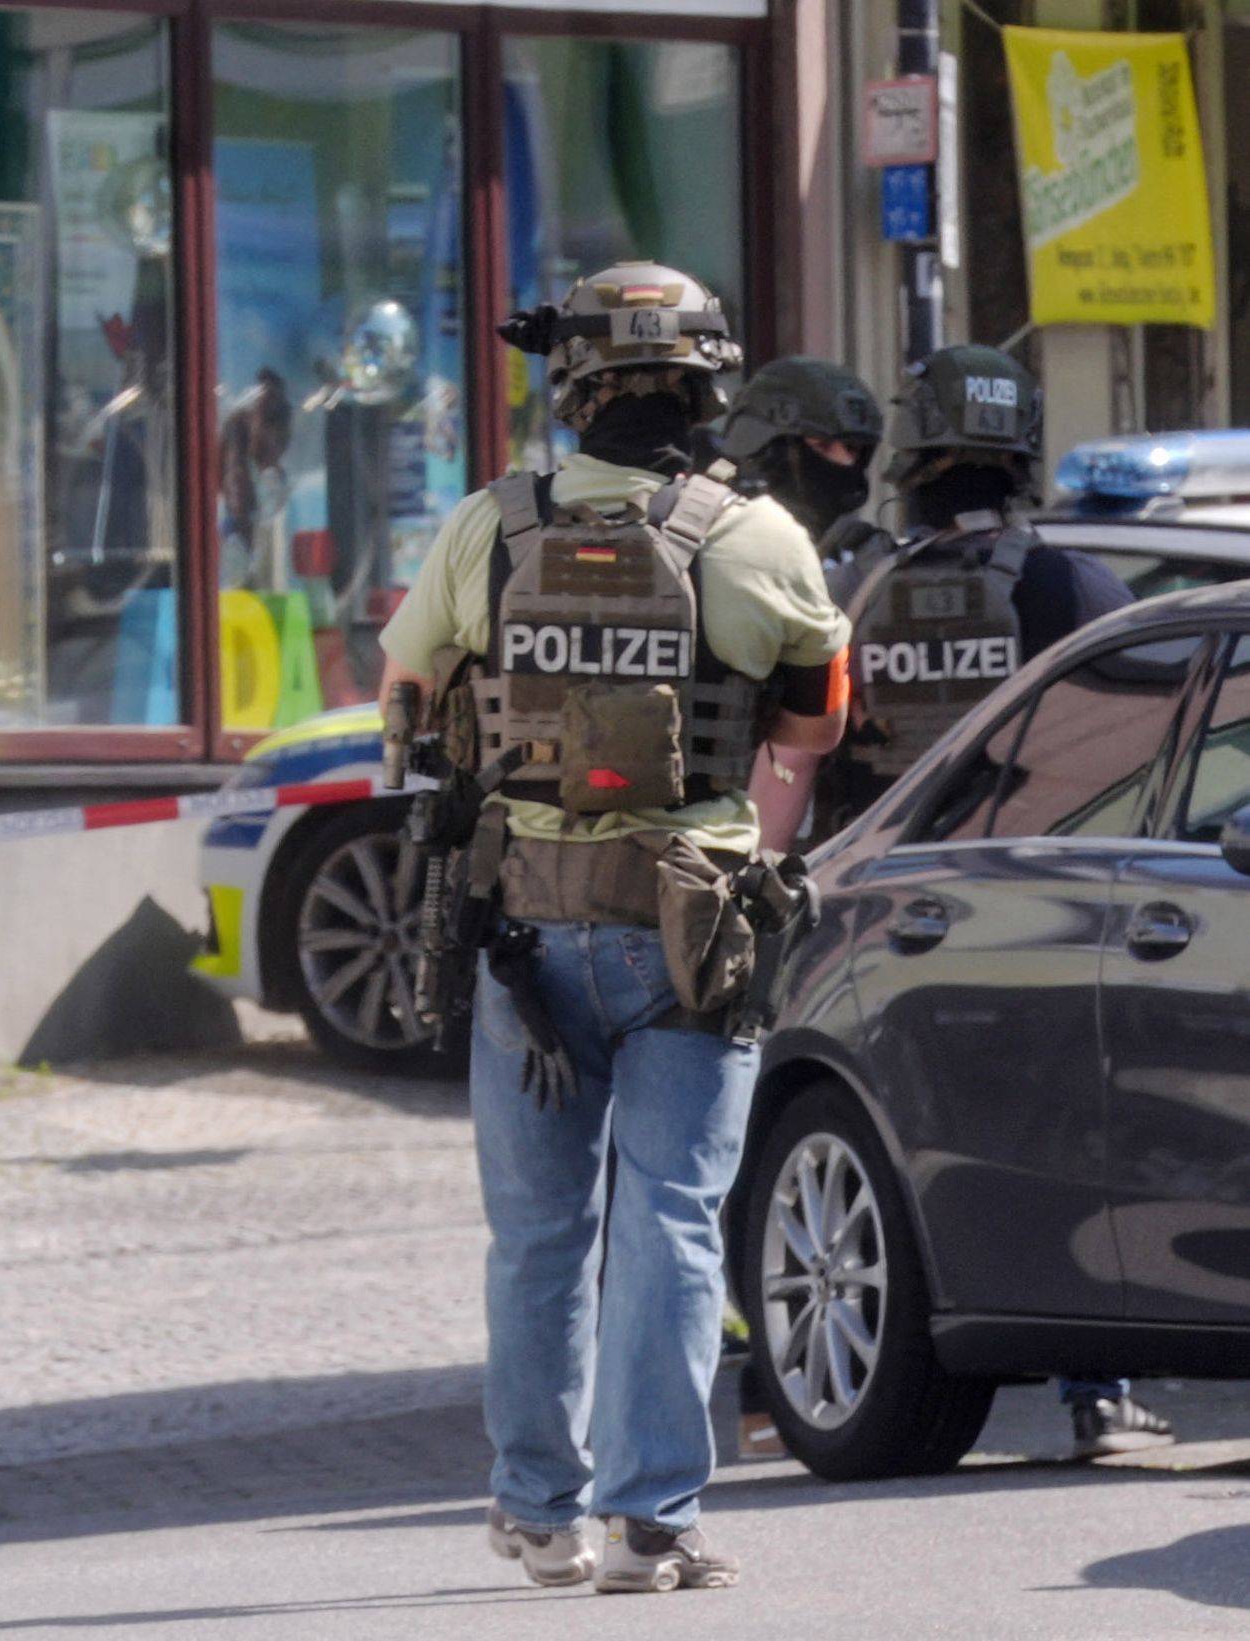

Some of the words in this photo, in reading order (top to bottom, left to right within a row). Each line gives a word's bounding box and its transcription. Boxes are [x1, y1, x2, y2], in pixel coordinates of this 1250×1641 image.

[629, 311, 662, 338] 43
[965, 376, 1018, 407] POLIZEI
[503, 623, 691, 677] POLIZEI
[860, 636, 1018, 683] POLIZEI
